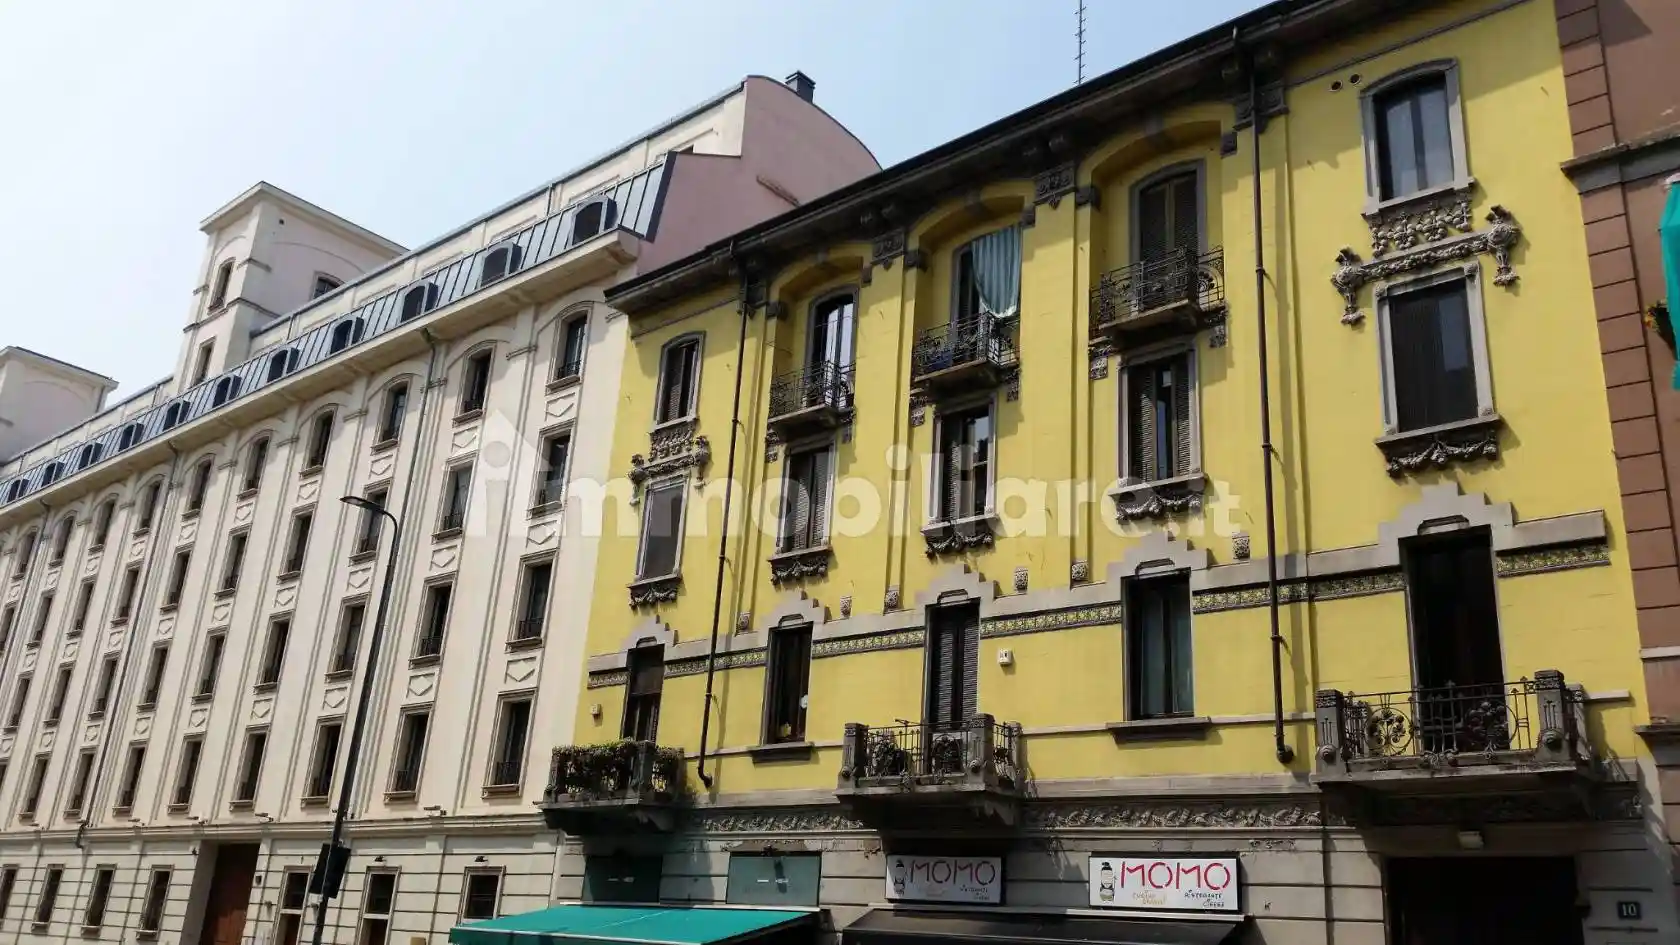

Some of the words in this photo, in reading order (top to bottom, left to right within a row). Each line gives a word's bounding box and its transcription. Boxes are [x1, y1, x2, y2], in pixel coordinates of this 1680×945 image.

[910, 859, 996, 886] MOMO
[1120, 861, 1231, 890] MOMO
[1622, 903, 1637, 916] 10
